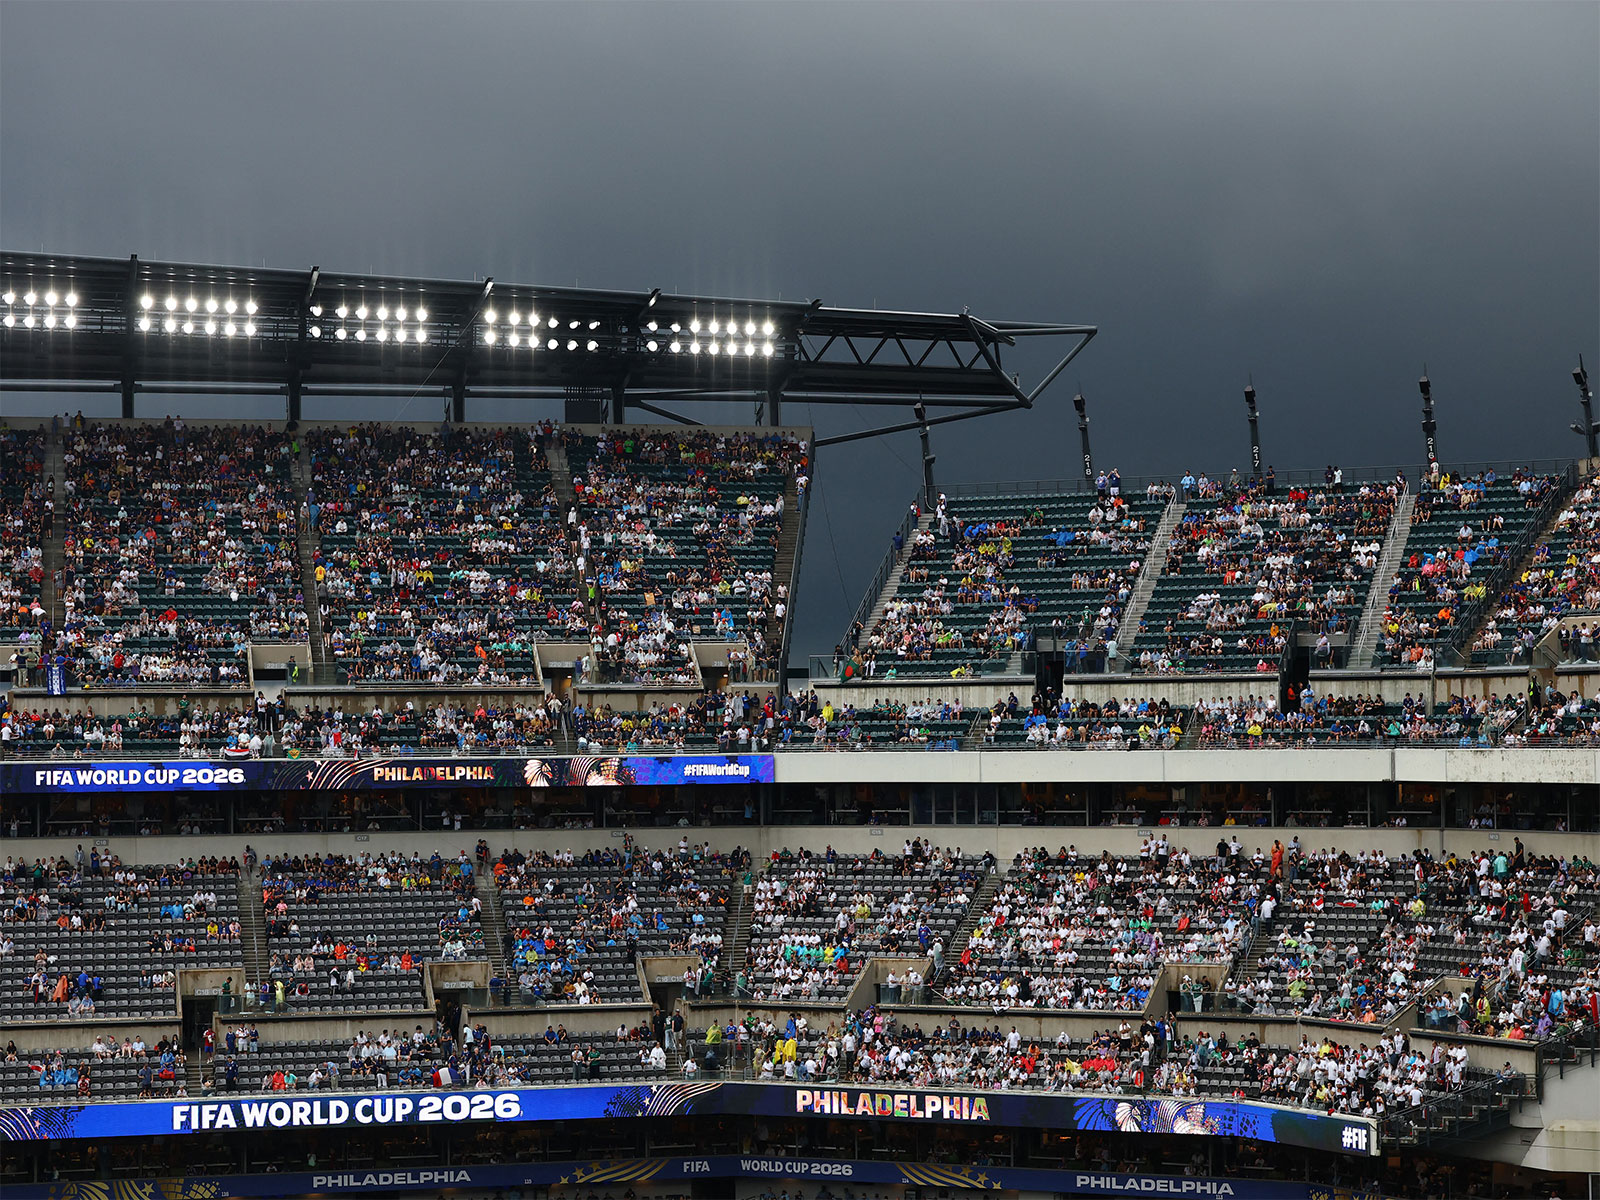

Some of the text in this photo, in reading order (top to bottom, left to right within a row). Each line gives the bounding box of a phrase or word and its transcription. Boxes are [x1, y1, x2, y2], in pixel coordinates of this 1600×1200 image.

[1252, 445, 1260, 468] 217
[1426, 437, 1435, 460] 216
[35, 768, 244, 786] FIFA WORLD CUP 2026
[373, 766, 495, 781] PHILADELPHIA
[683, 763, 750, 778] #FIFAWorldCup
[172, 1093, 520, 1131] FIFA WORLD CUP 2026
[796, 1089, 990, 1121] PHILADELPHIA
[1341, 1126, 1368, 1151] #FIF
[683, 1159, 853, 1176] FIFA WORLD CUP 2026
[312, 1170, 471, 1188] PHILADELPHIA
[1076, 1175, 1234, 1196] PHILADELPHIA
